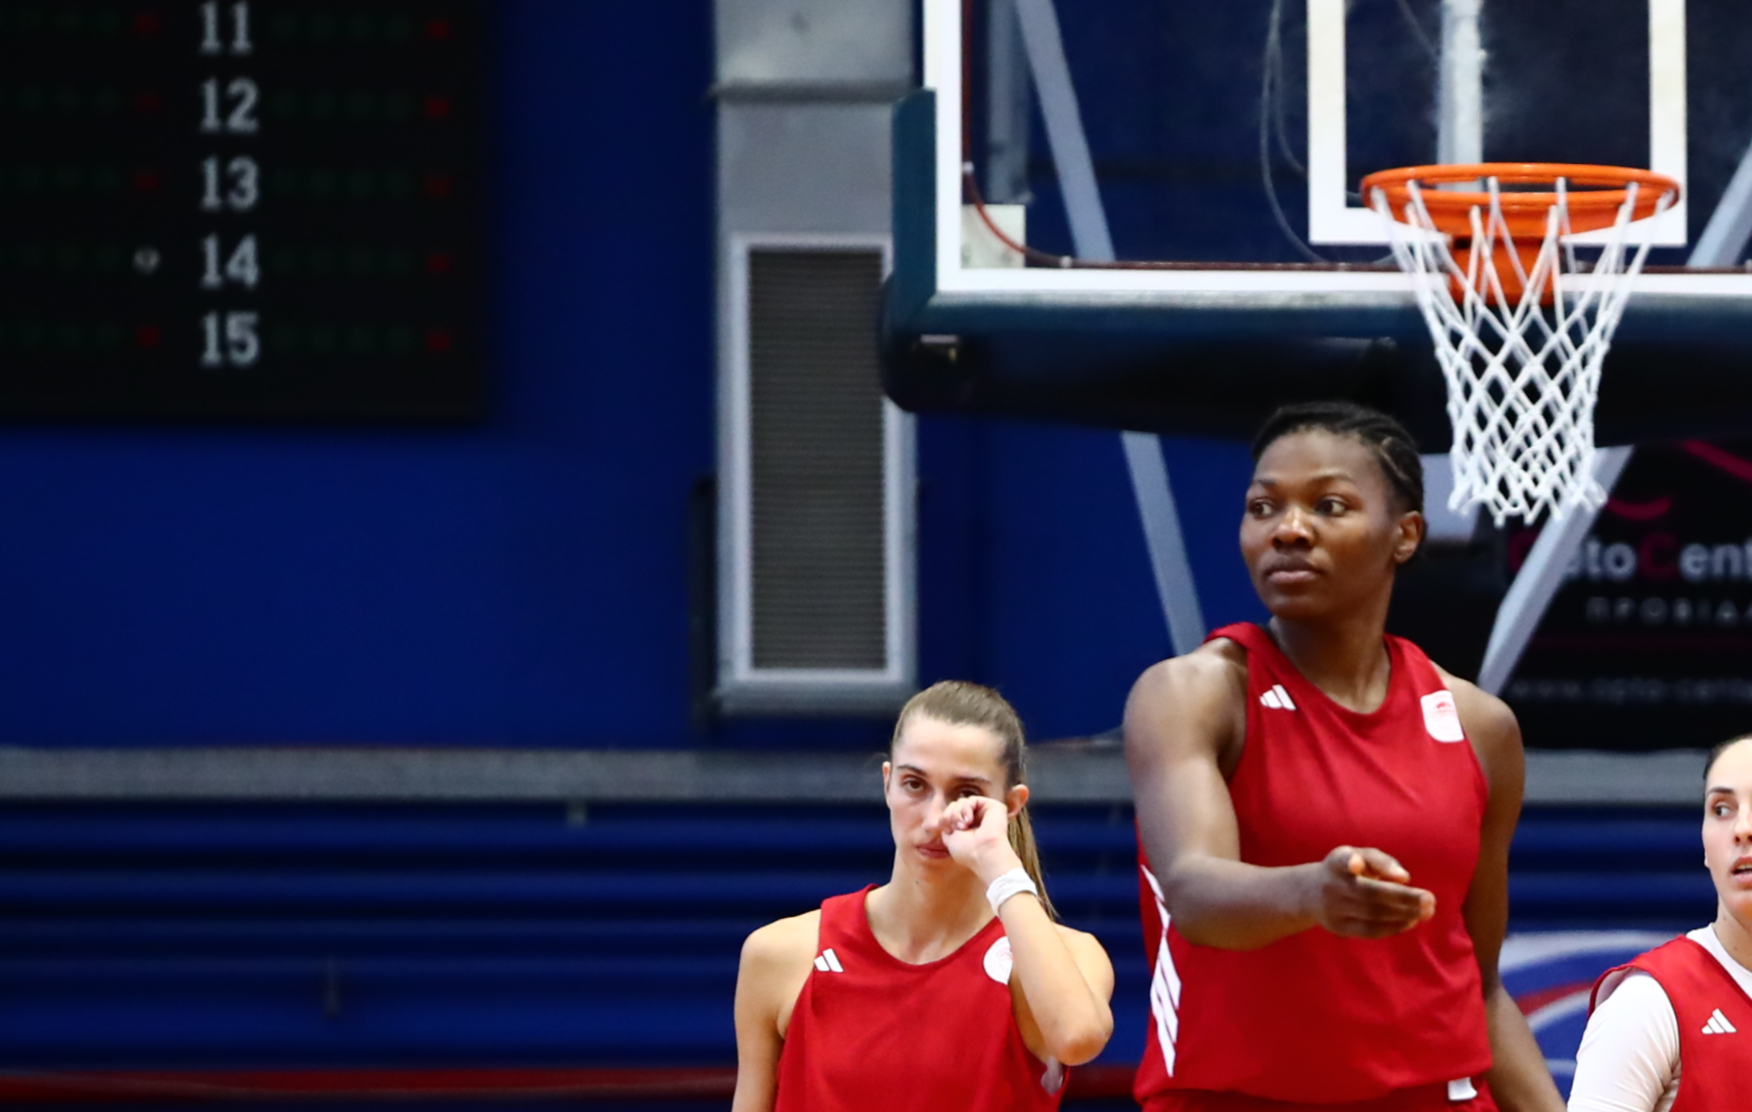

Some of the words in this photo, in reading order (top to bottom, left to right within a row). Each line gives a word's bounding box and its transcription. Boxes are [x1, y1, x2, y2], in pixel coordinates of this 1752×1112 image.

[201, 1, 252, 53] 11
[201, 78, 258, 132] 12
[201, 156, 259, 210] 13
[201, 234, 259, 288] 14
[201, 311, 259, 366] 15
